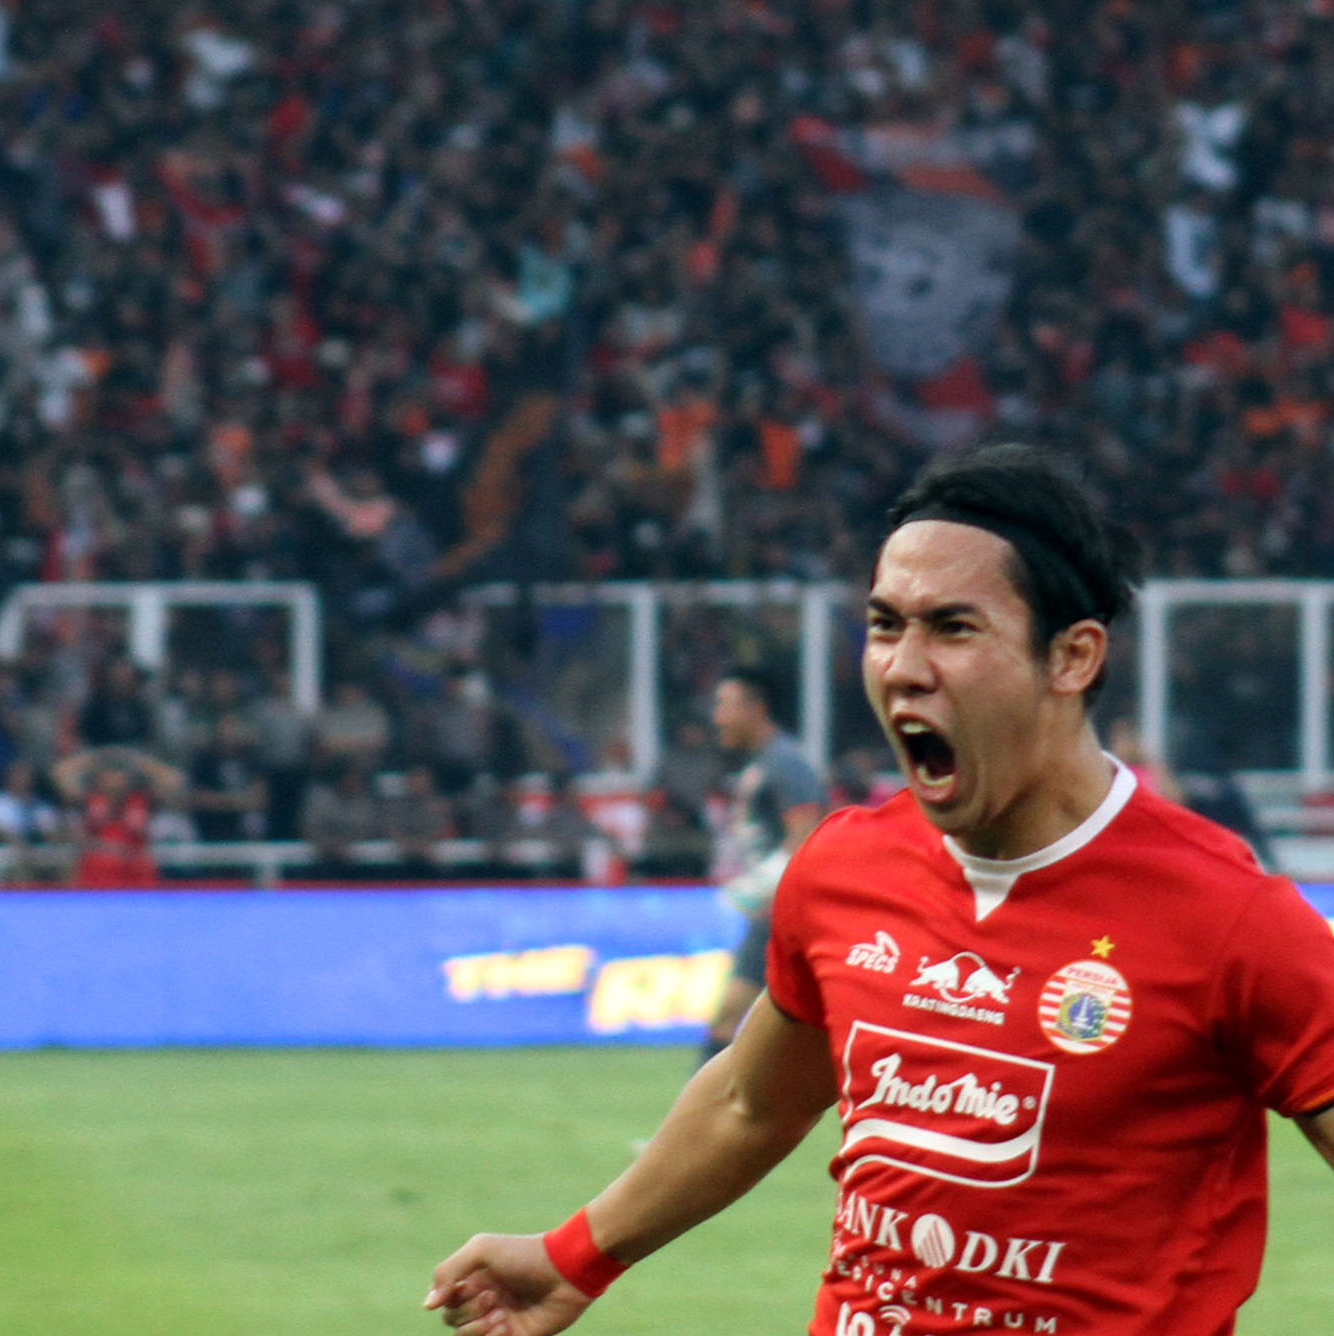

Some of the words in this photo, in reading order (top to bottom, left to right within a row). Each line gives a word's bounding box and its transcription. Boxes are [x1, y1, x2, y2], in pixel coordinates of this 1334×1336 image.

[846, 948, 899, 973] SPECS
[902, 993, 1005, 1025] KRATINGDAENG
[954, 1230, 1067, 1283] DKI
